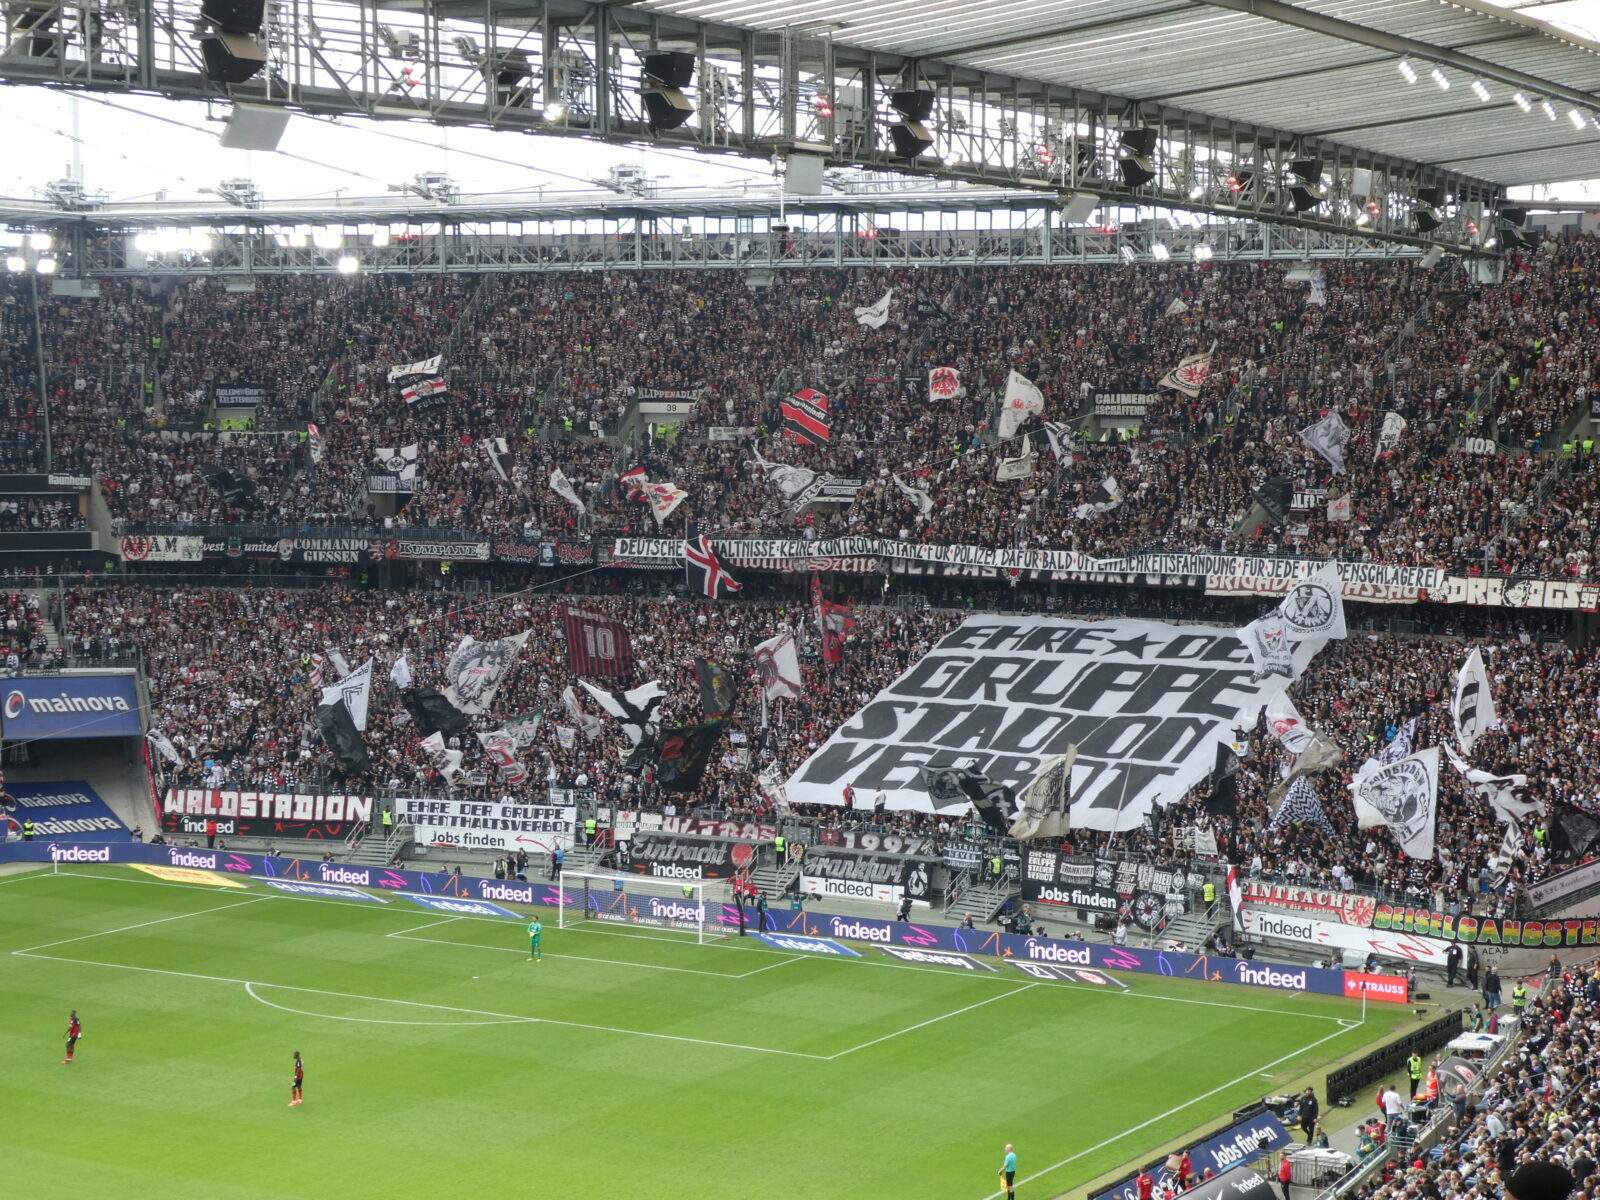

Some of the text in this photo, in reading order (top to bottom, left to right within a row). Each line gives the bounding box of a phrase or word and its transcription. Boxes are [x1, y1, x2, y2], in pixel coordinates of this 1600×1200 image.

[666, 404, 678, 412] 39
[1095, 393, 1161, 405] CALIMEROS
[1465, 437, 1497, 455] MOB
[48, 474, 91, 486] Raunheim
[201, 540, 279, 553] west united
[294, 538, 368, 551] COMMANDO
[303, 550, 359, 563] GIESSEN
[620, 539, 683, 557] DEUTSCHE
[781, 540, 814, 557] KEINE
[1042, 552, 1073, 570] BALD
[1266, 560, 1300, 579] JEDE
[583, 624, 615, 660] 10
[936, 624, 1285, 664] EHRE DE
[890, 655, 1262, 720] GRUPPE
[28, 692, 130, 713] mainova
[840, 699, 1220, 764] STADION
[18, 791, 91, 808] mainova
[164, 788, 373, 822] WALDSTADION
[406, 801, 565, 821] EHRE DER GRUPPE
[33, 816, 121, 836] mainova
[183, 817, 234, 835] inded
[401, 813, 573, 833] AUFENTHALTSVERBOT
[430, 830, 505, 848] Jobs finden
[844, 832, 924, 856] 1997
[946, 841, 980, 852] ULTRAS
[50, 845, 109, 861] indeed
[630, 834, 728, 866] Eintracht
[948, 851, 977, 861] NEVER
[170, 852, 216, 869] indeed
[321, 865, 369, 886] indeed
[653, 862, 702, 880] indeed
[480, 881, 532, 903] indeed
[825, 879, 874, 897] indeed
[1037, 886, 1117, 909] Jobs finden
[1241, 882, 1359, 911] EINTRACHT
[651, 898, 704, 921] indeed
[832, 918, 891, 943] indeed
[1259, 917, 1312, 940] indeed
[1028, 940, 1090, 965] indeed
[1481, 947, 1509, 955] ACAB
[1238, 963, 1305, 990] indeed
[1358, 980, 1404, 995] STRAUSS
[1210, 1125, 1278, 1168] Jobs finden
[1234, 1172, 1265, 1194] indeed
